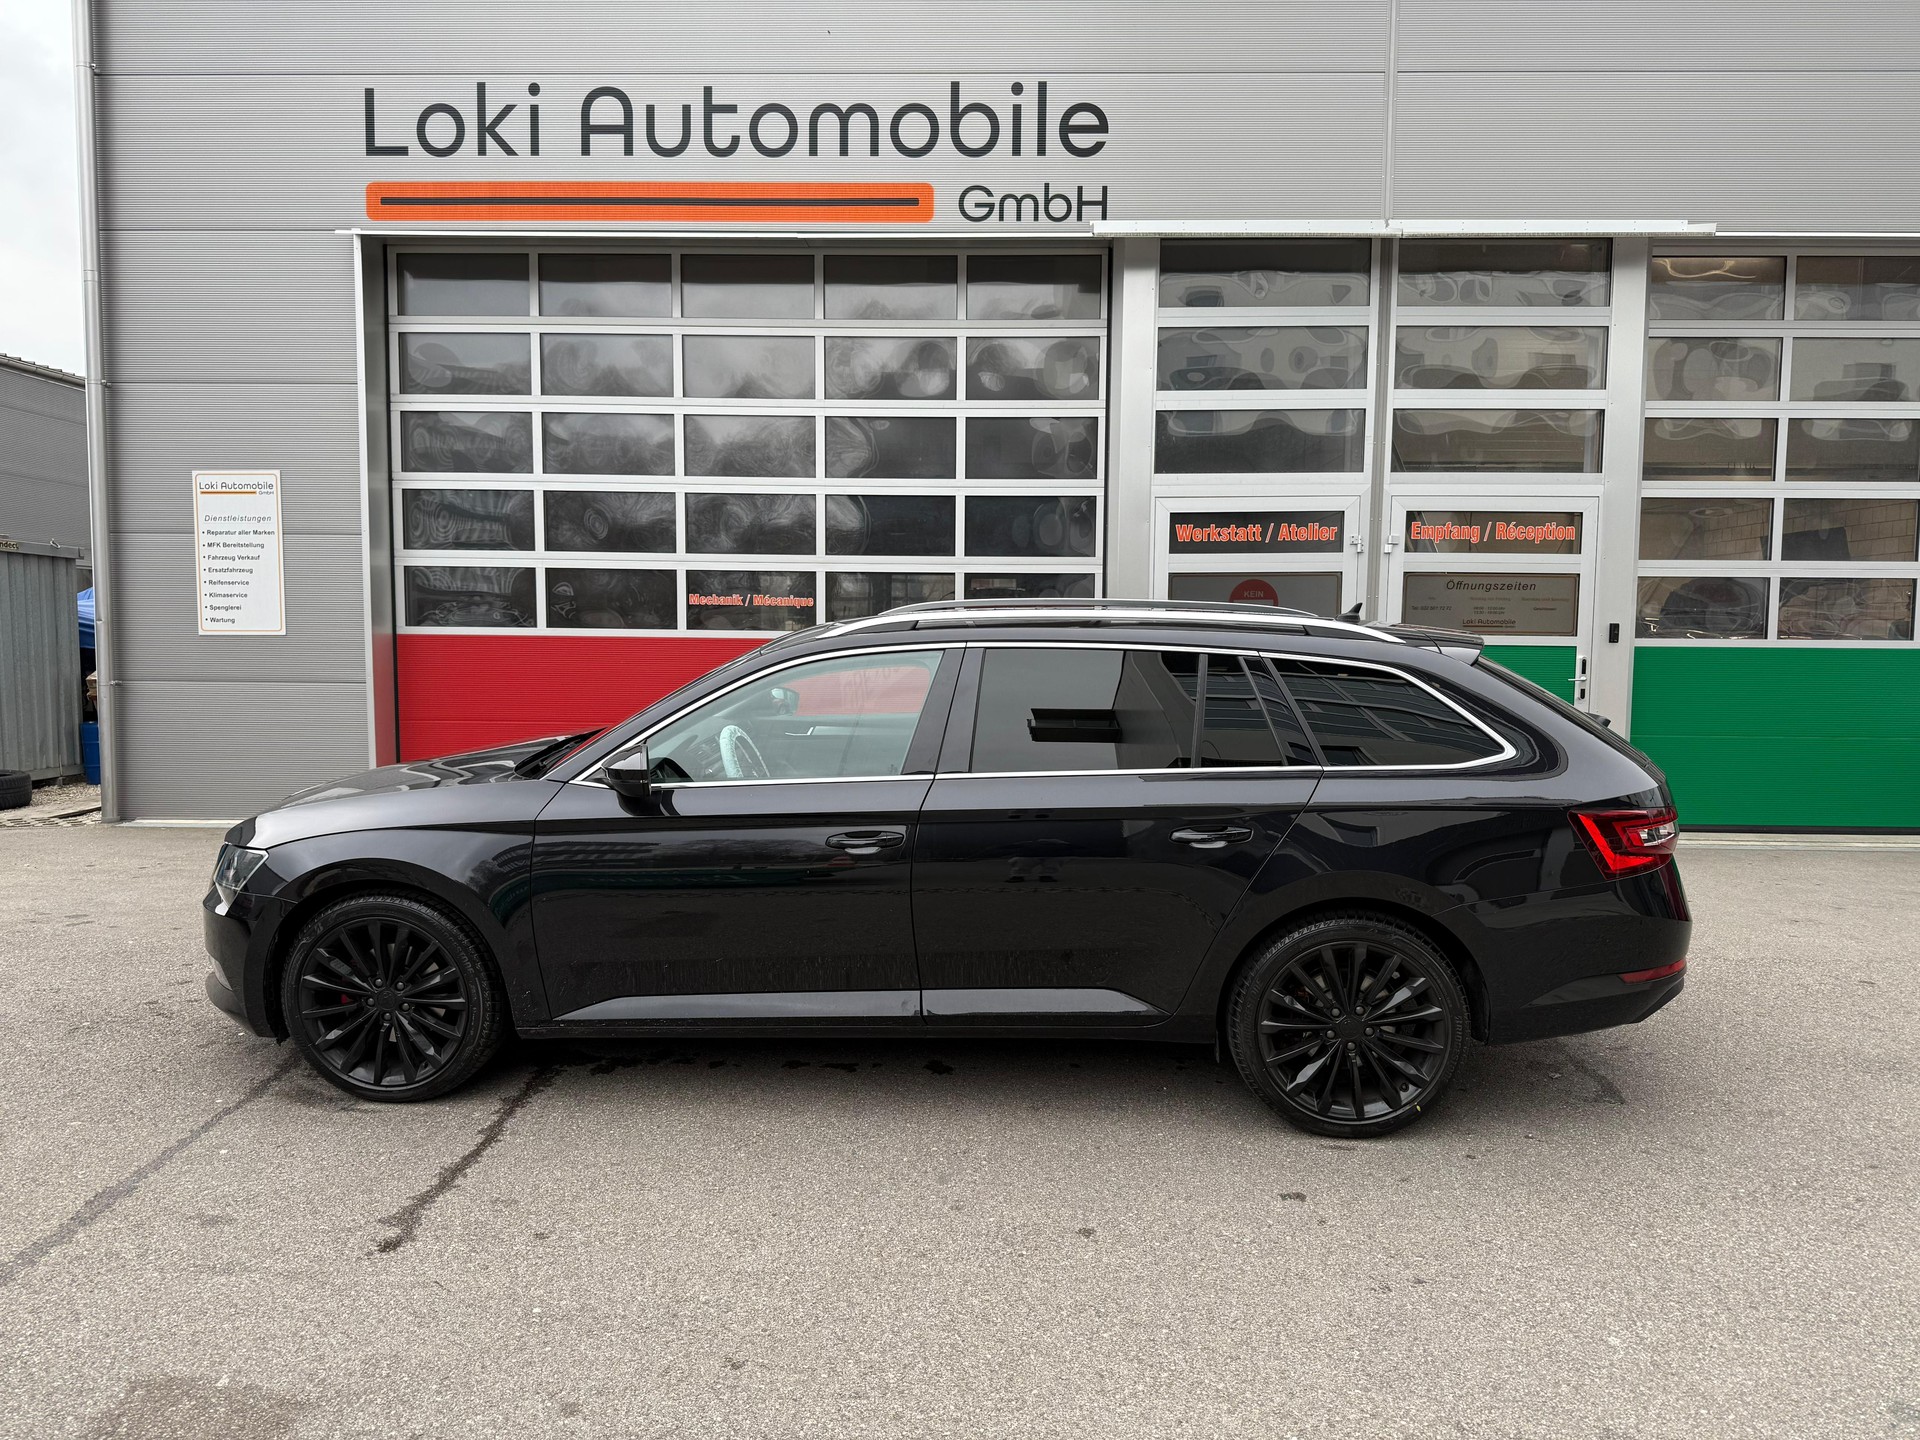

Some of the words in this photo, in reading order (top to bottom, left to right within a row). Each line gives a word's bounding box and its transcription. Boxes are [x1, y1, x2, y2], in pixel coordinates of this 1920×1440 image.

[365, 82, 541, 158] Loki
[580, 81, 1109, 159] Automobile
[957, 183, 1109, 223] GmbH
[199, 481, 218, 490] Loki
[220, 481, 274, 490] Automobile
[204, 514, 272, 524] Dienstleistungen
[206, 529, 237, 537] Reparatur
[1175, 523, 1262, 542] Werkstatt
[1264, 522, 1275, 544] /
[1277, 523, 1338, 542] Atelier
[1411, 521, 1481, 544] Empfang
[1483, 521, 1492, 542] /
[1495, 521, 1576, 544] Réception
[222, 542, 265, 550] Bereitstellung
[207, 554, 236, 562] Fahrzeug
[1446, 580, 1537, 593] Öffnungszeiten
[1243, 590, 1264, 598] KEIN
[688, 593, 744, 606] Mechanik
[752, 594, 814, 609] Mécanique
